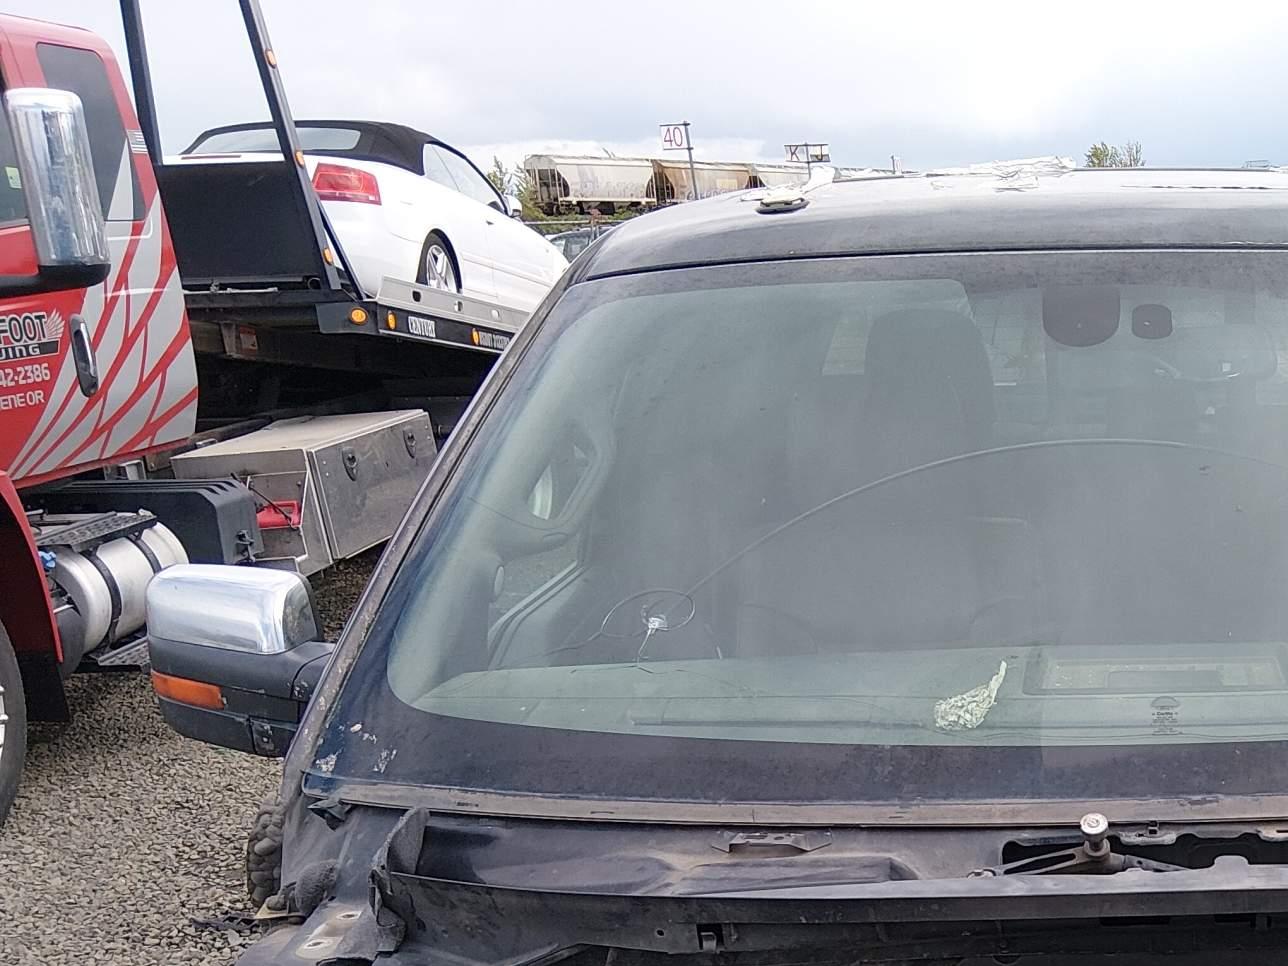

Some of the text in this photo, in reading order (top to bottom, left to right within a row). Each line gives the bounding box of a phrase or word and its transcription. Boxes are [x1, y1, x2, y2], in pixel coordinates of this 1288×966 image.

[663, 126, 683, 147] 40
[790, 145, 799, 161] K
[26, 390, 45, 406] OR
